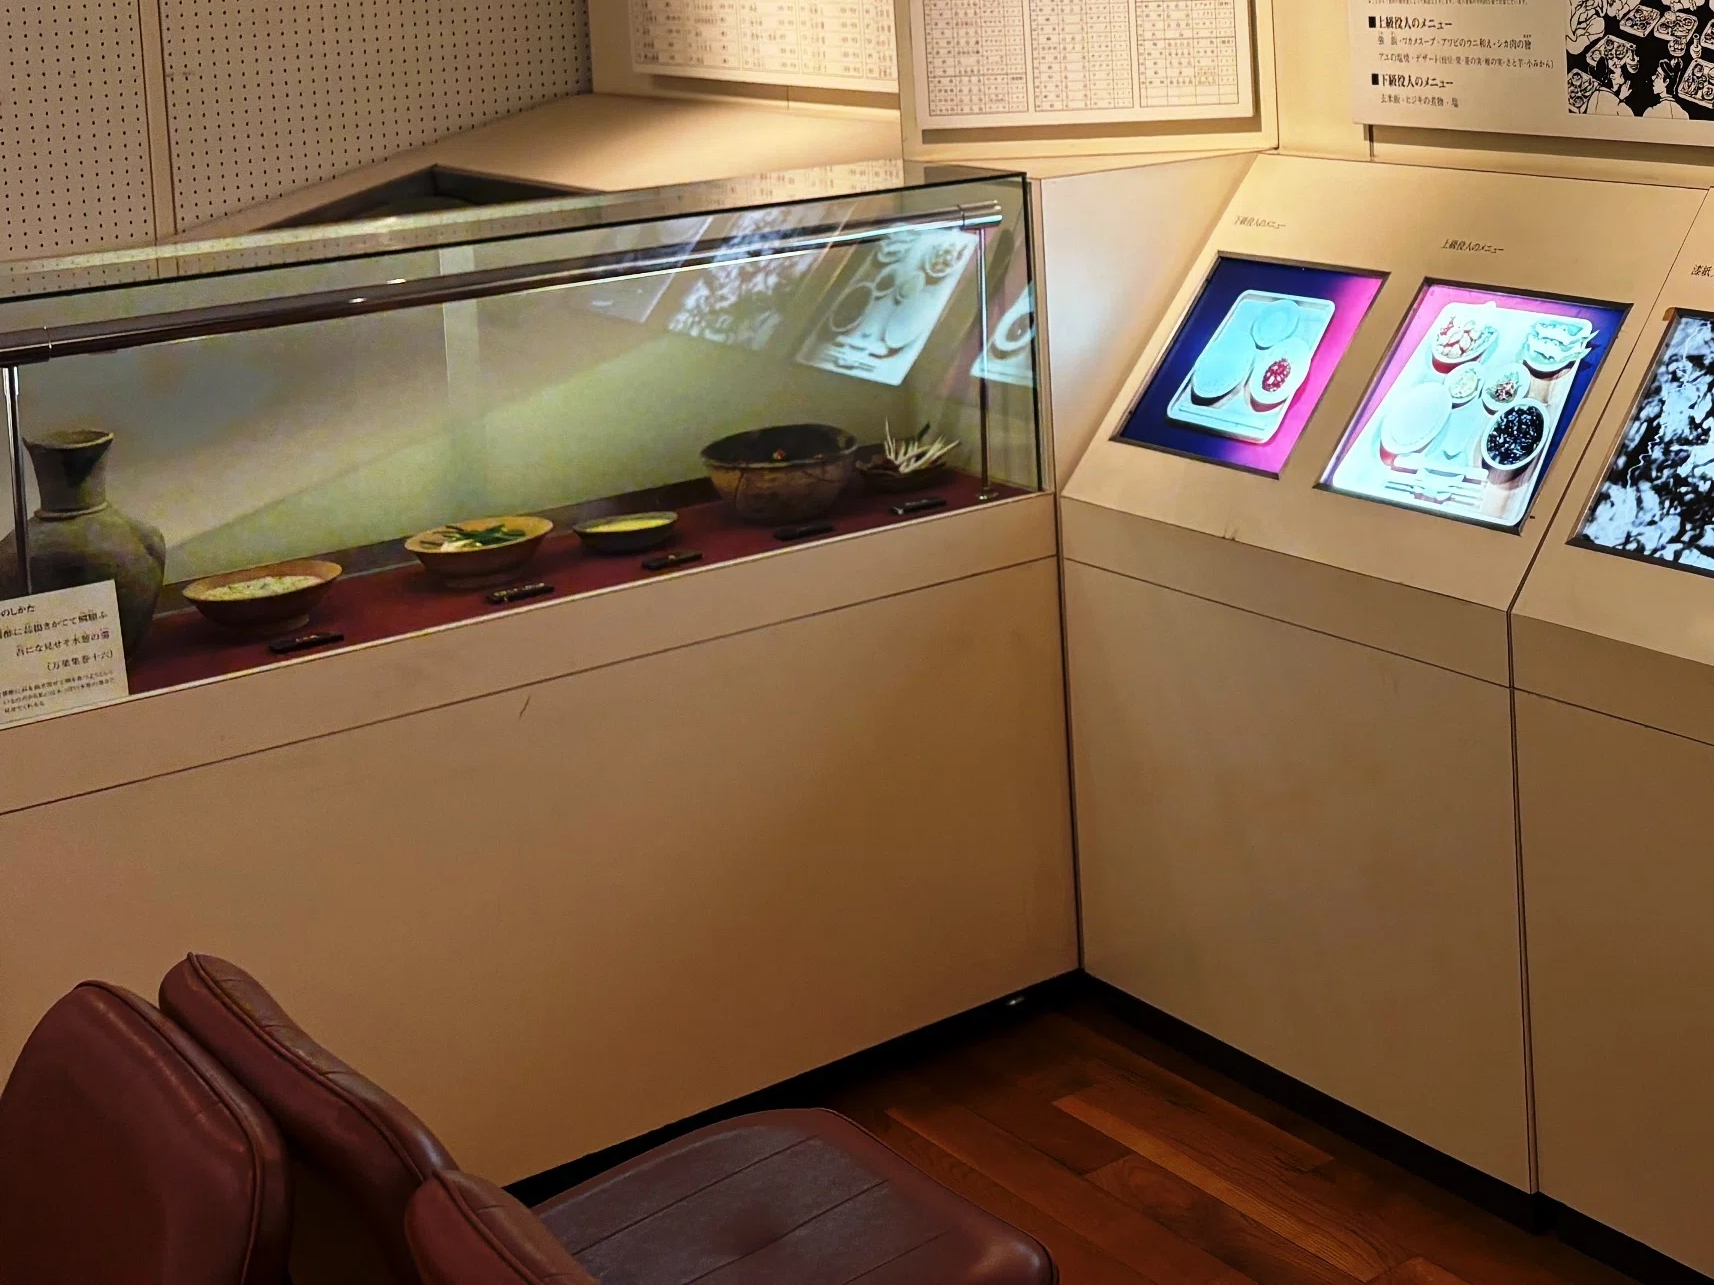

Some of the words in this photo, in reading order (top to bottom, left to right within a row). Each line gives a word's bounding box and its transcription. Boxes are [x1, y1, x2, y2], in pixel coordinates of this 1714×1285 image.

[1378, 16, 1453, 30] 上級役人のメニュー
[1381, 73, 1454, 89] 下級役人のメニュー
